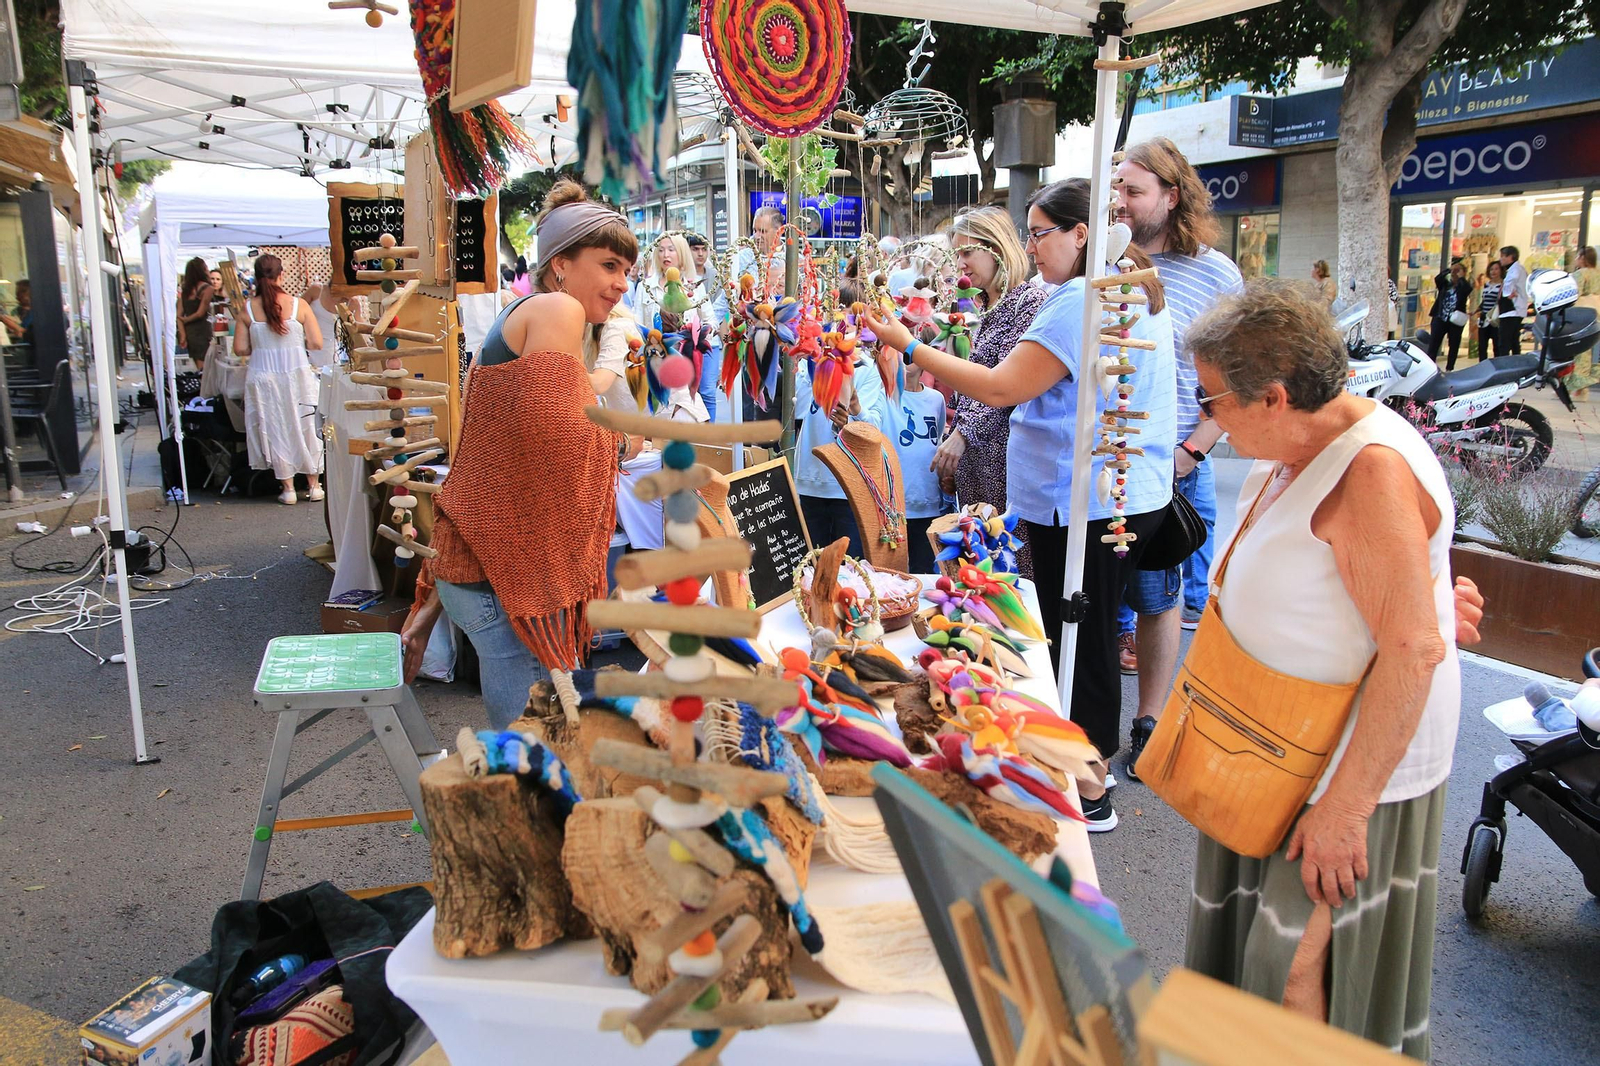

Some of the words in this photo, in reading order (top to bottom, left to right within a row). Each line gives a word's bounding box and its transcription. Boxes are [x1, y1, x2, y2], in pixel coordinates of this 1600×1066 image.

[1425, 75, 1453, 98] AY
[1458, 56, 1555, 92] BEAUTY
[1414, 108, 1448, 120] elleza
[1467, 94, 1529, 112] Bienestar
[1397, 141, 1532, 189] pepco
[1346, 374, 1369, 387] OLICIA
[1370, 369, 1392, 382] LOCAL
[740, 487, 749, 501] de
[745, 507, 753, 516] te
[755, 494, 783, 512] acompañe
[748, 523, 756, 534] de
[757, 519, 767, 529] las
